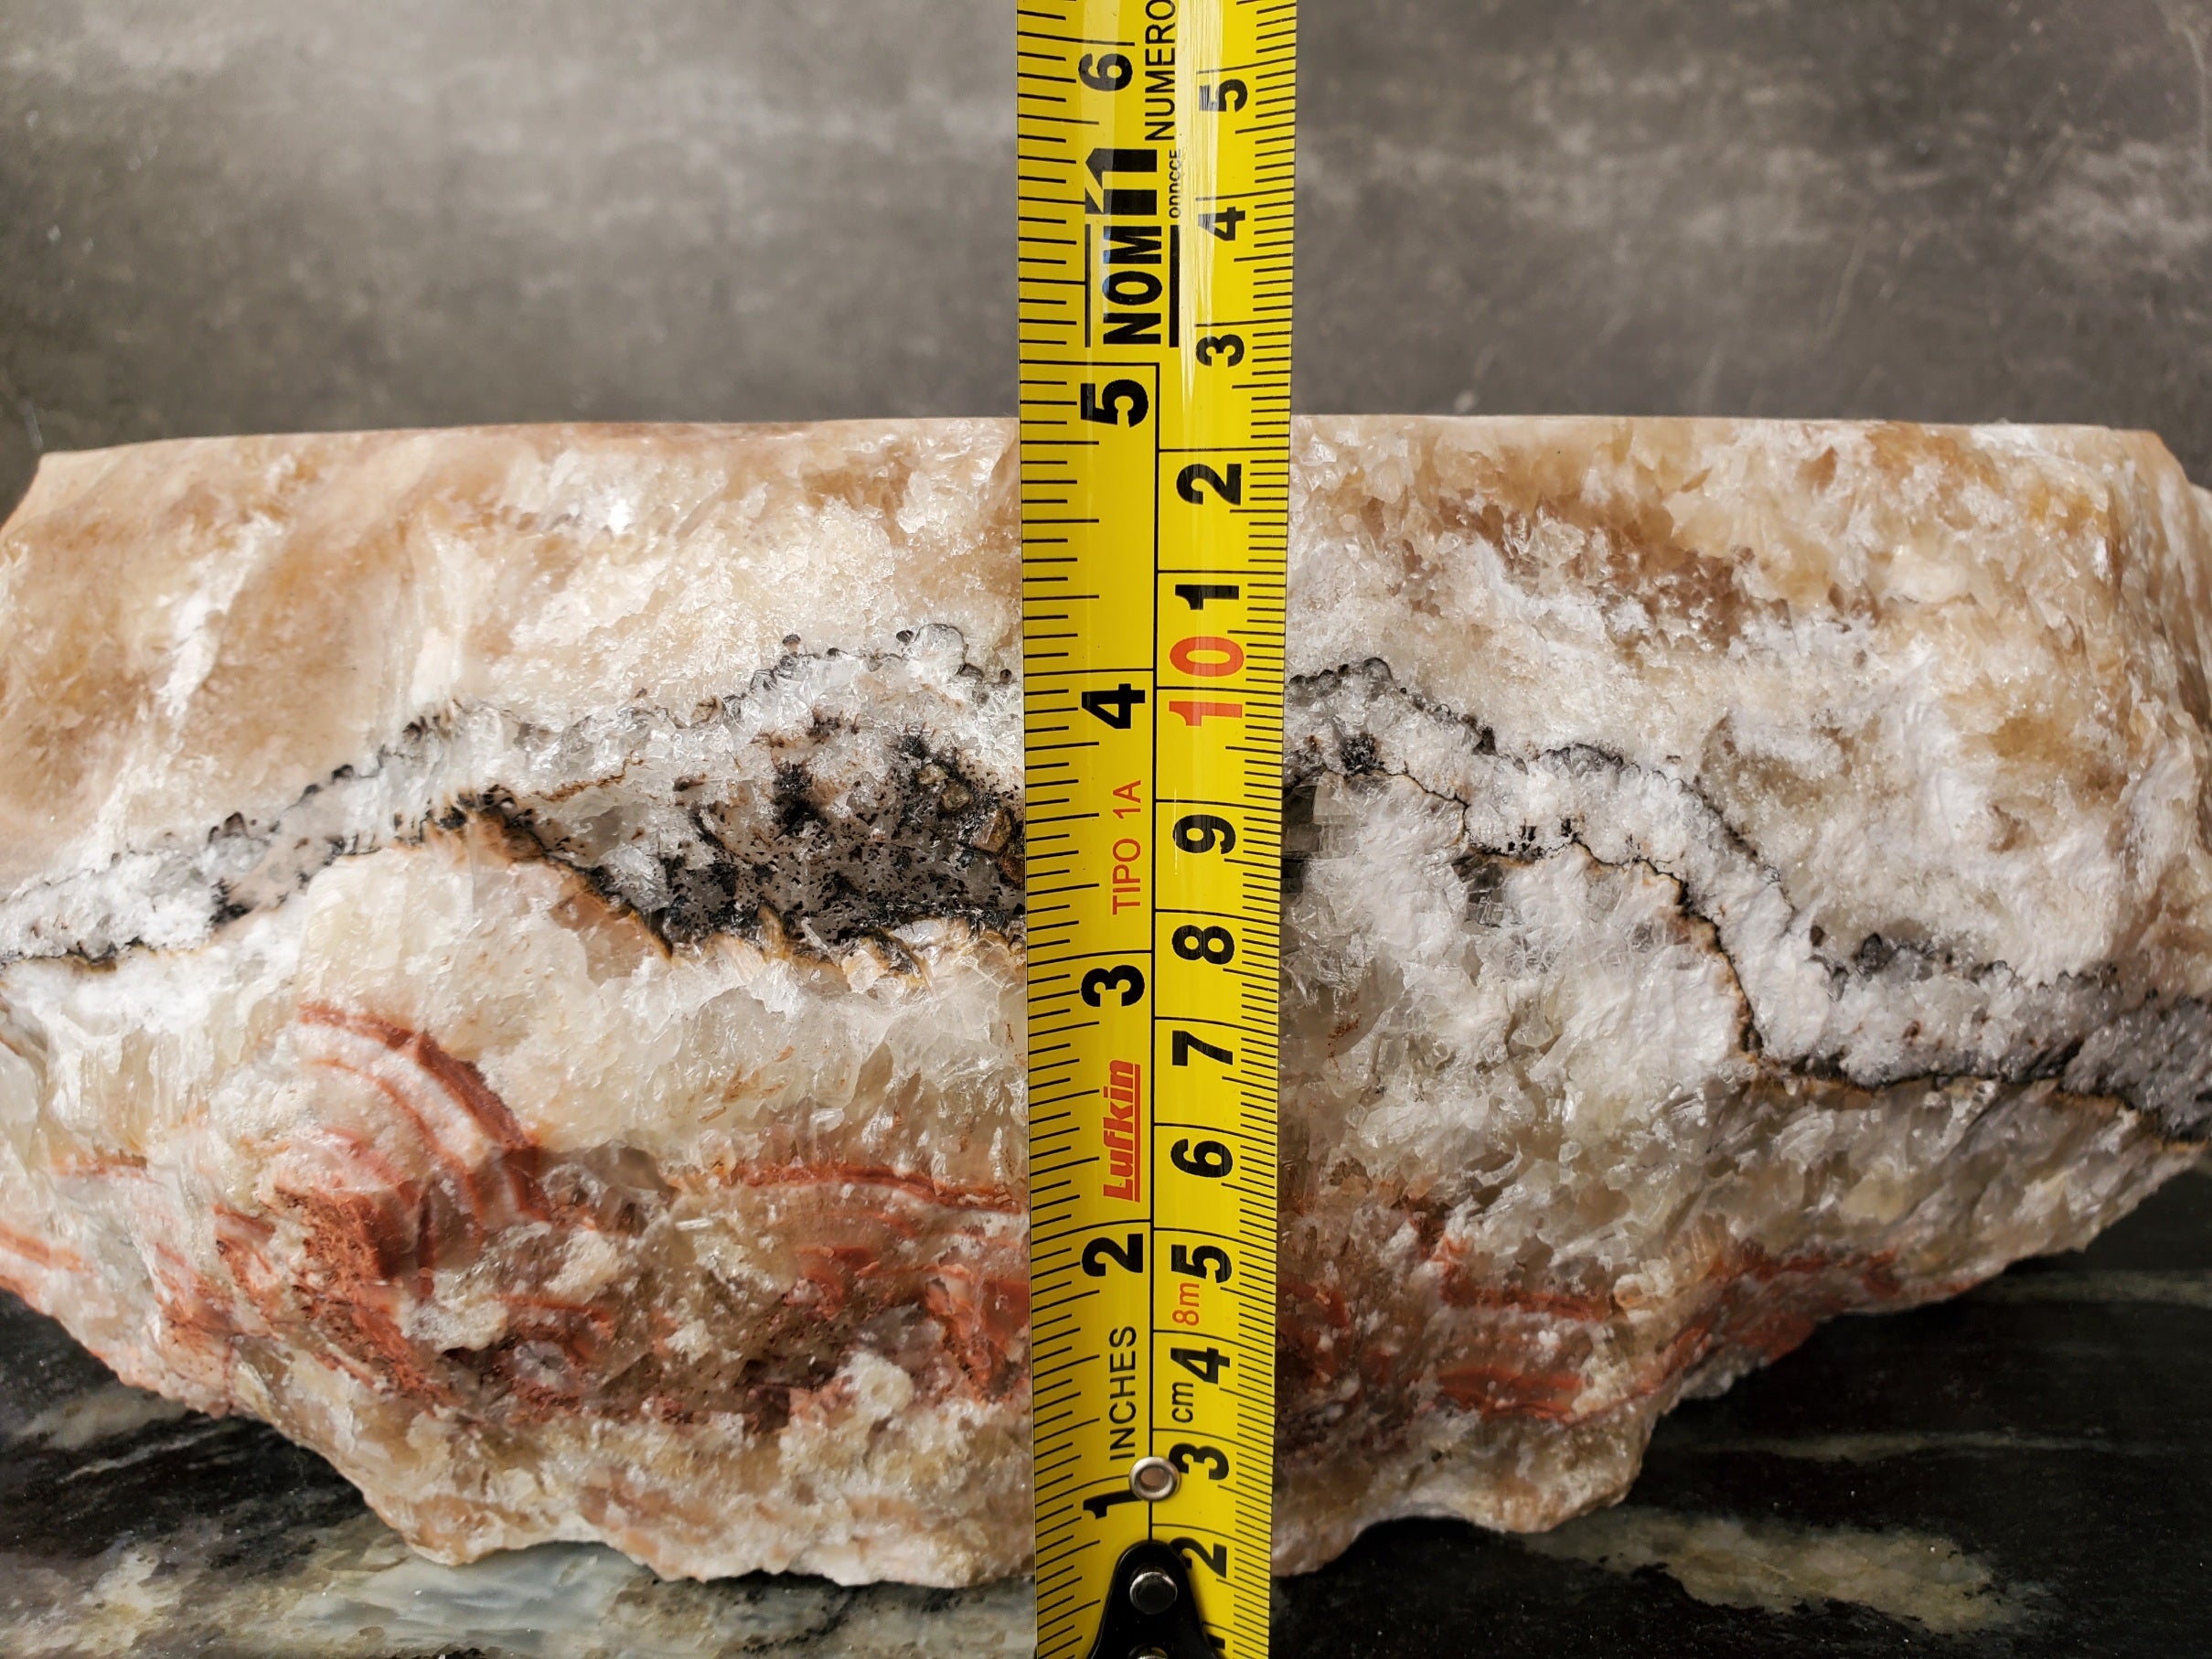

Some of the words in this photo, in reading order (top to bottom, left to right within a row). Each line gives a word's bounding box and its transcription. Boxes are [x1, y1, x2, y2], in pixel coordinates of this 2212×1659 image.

[1078, 53, 1133, 91] 6
[1145, 0, 1176, 141] NUMERO
[1199, 79, 1247, 112] 5
[1198, 207, 1245, 241] 4
[1102, 226, 1162, 344] NOM
[1196, 334, 1245, 368] 3
[1080, 379, 1149, 428] 5
[1176, 463, 1242, 506] 2
[1174, 584, 1240, 610] 1
[1169, 637, 1245, 727] 10
[1081, 683, 1145, 729] 4
[1112, 779, 1141, 819] 1A
[1172, 814, 1236, 854] 9
[1112, 838, 1141, 915] TIPO
[1171, 925, 1234, 965] 8
[1081, 964, 1145, 1007] 3
[1171, 1030, 1234, 1066] 7
[1103, 1059, 1135, 1202] Lufkin
[1170, 1138, 1234, 1178] 6
[1082, 1233, 1143, 1277] 2
[1171, 1244, 1232, 1283] 5
[1172, 1282, 1200, 1326] 8m
[1170, 1347, 1230, 1385] 4
[1109, 1326, 1137, 1461] INCHES
[1171, 1382, 1193, 1423] cm
[1169, 1442, 1229, 1481] 3
[1083, 1490, 1142, 1519] 1
[1170, 1536, 1227, 1579] 2
